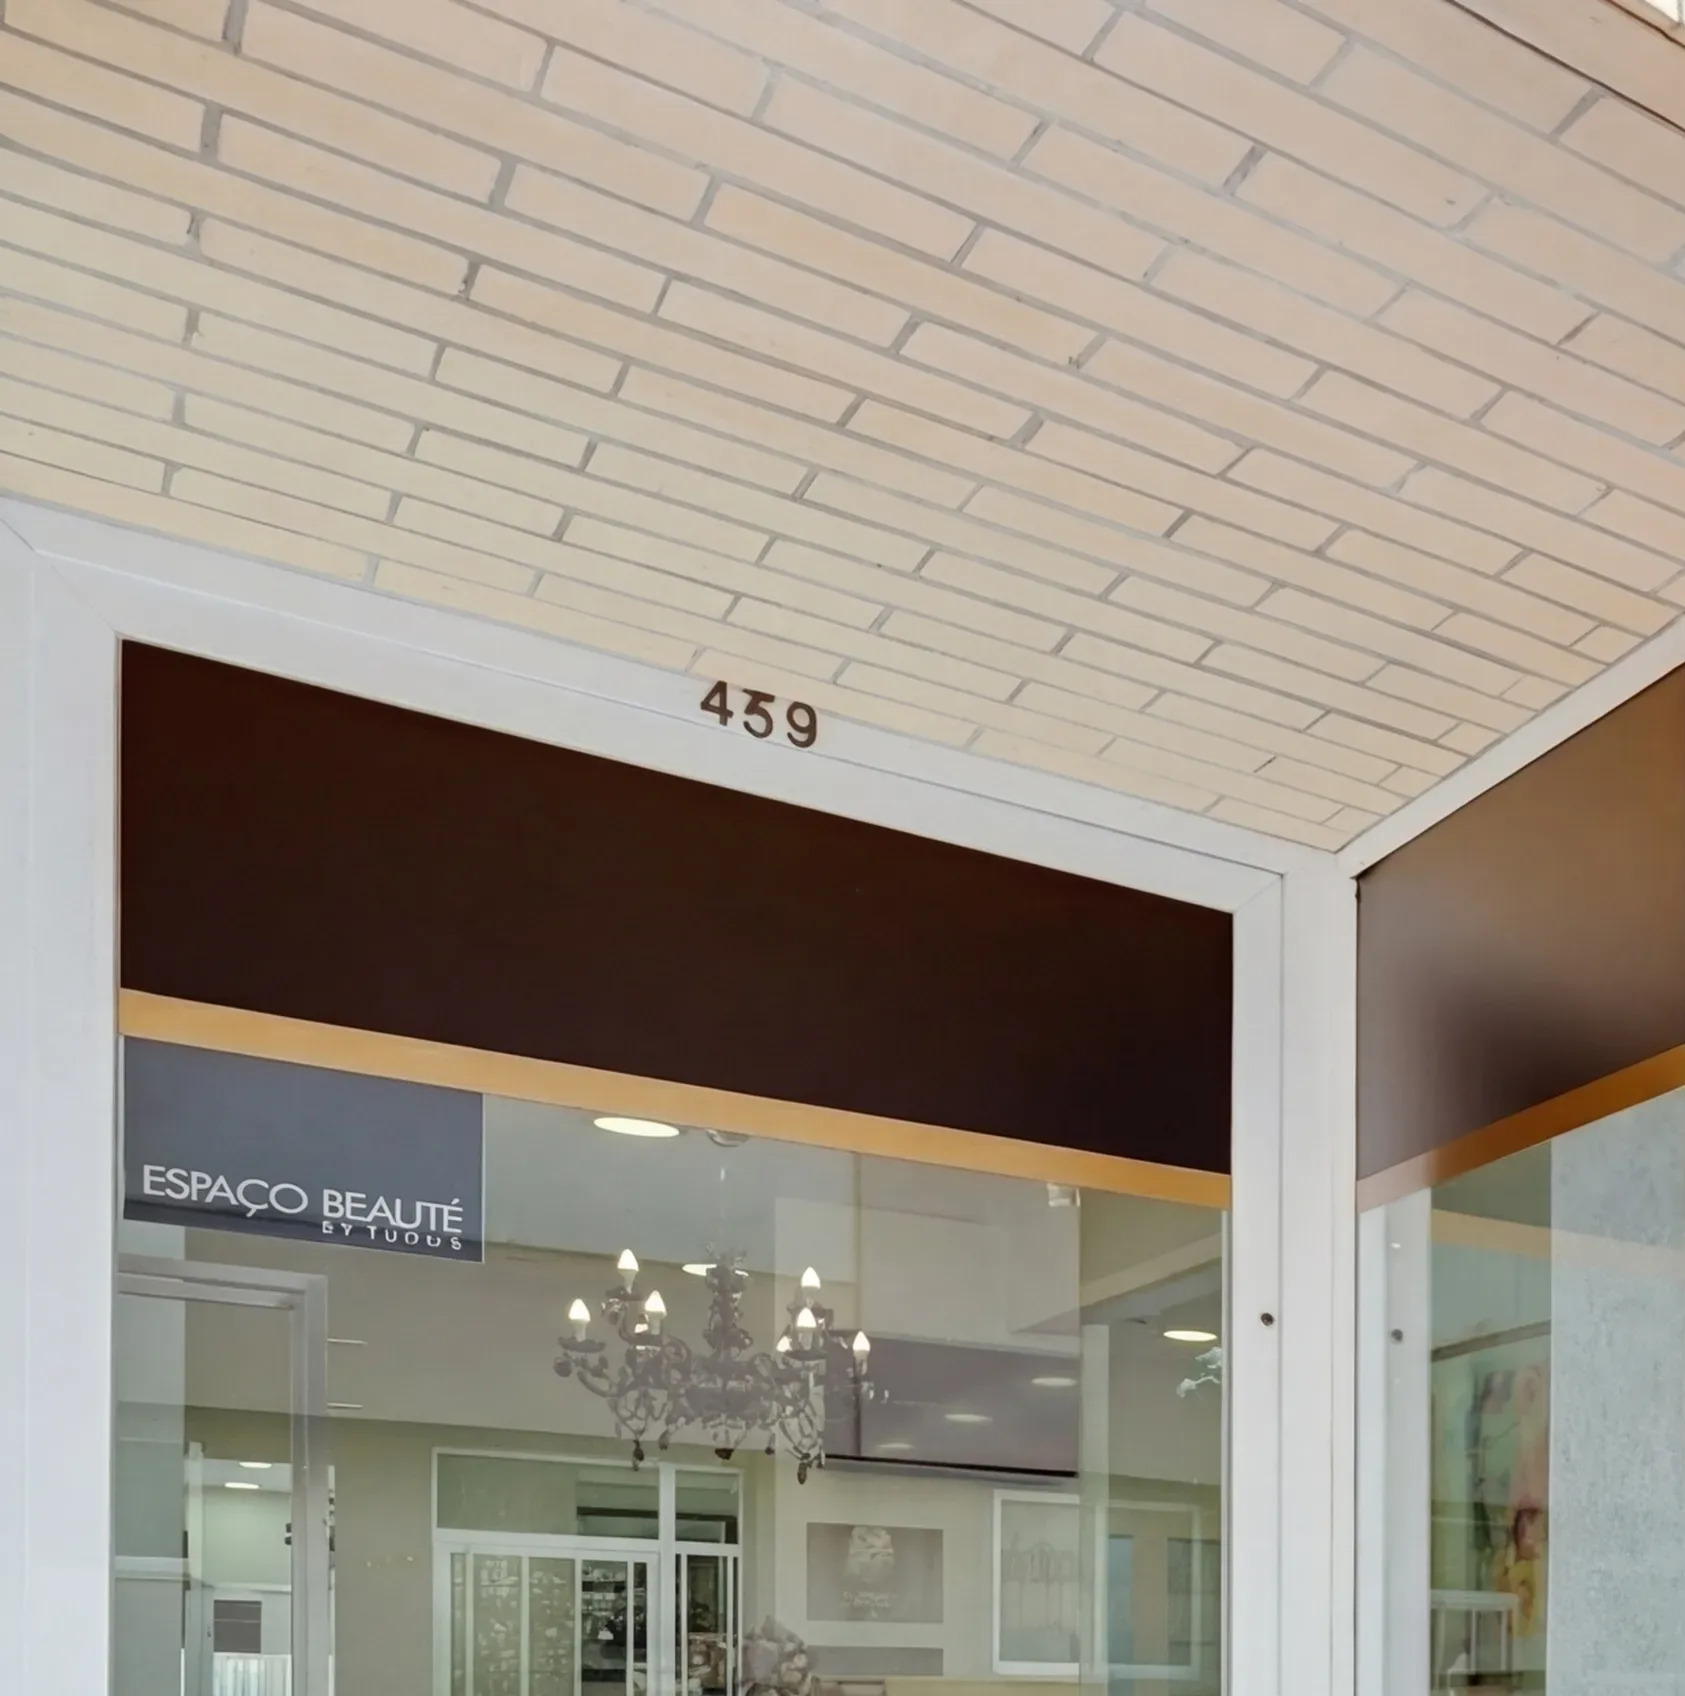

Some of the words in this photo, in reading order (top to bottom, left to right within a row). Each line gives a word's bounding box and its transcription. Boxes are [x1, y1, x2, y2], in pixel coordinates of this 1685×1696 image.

[700, 680, 817, 748] 459
[143, 1164, 309, 1217] ESPAÇO
[323, 1188, 463, 1234] BEAUTÉ
